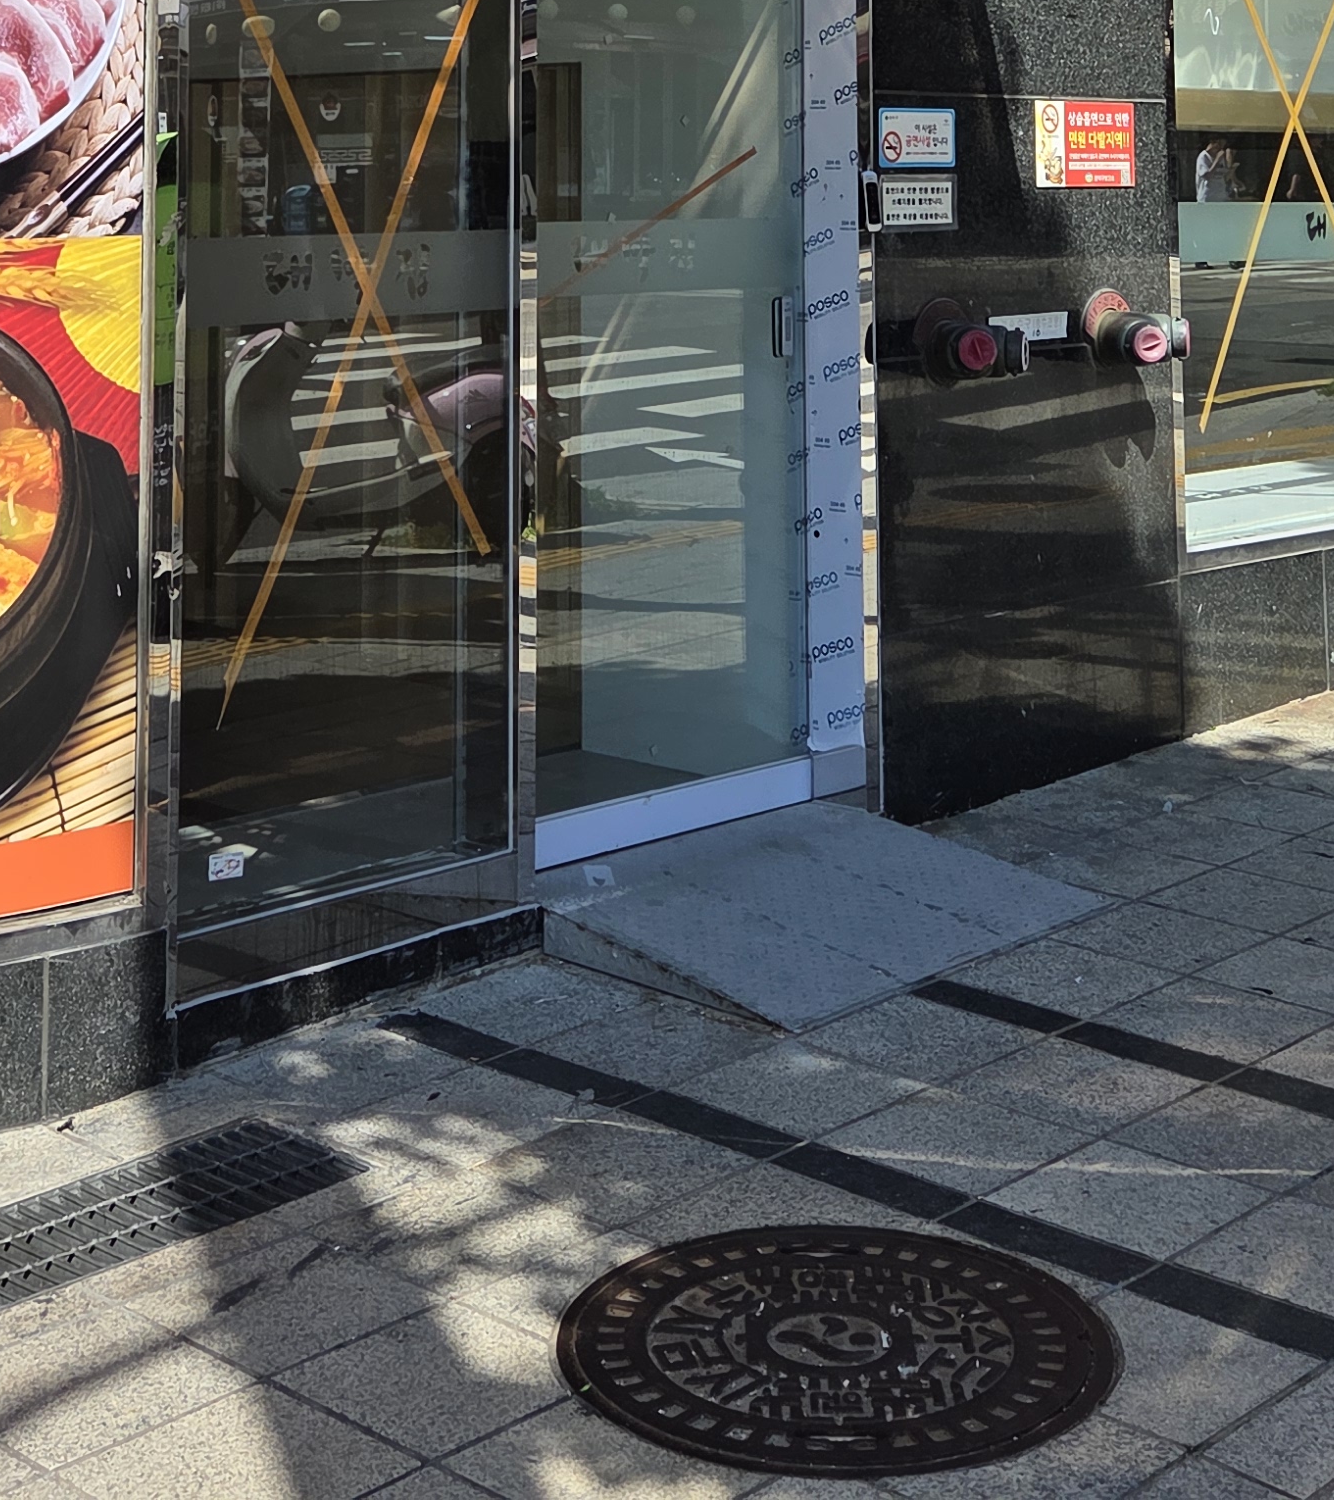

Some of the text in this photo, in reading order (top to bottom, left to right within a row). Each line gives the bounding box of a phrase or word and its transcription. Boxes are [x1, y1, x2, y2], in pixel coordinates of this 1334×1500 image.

[1068, 130, 1087, 149] 민원
[807, 290, 849, 320] posco
[811, 636, 854, 663] posco
